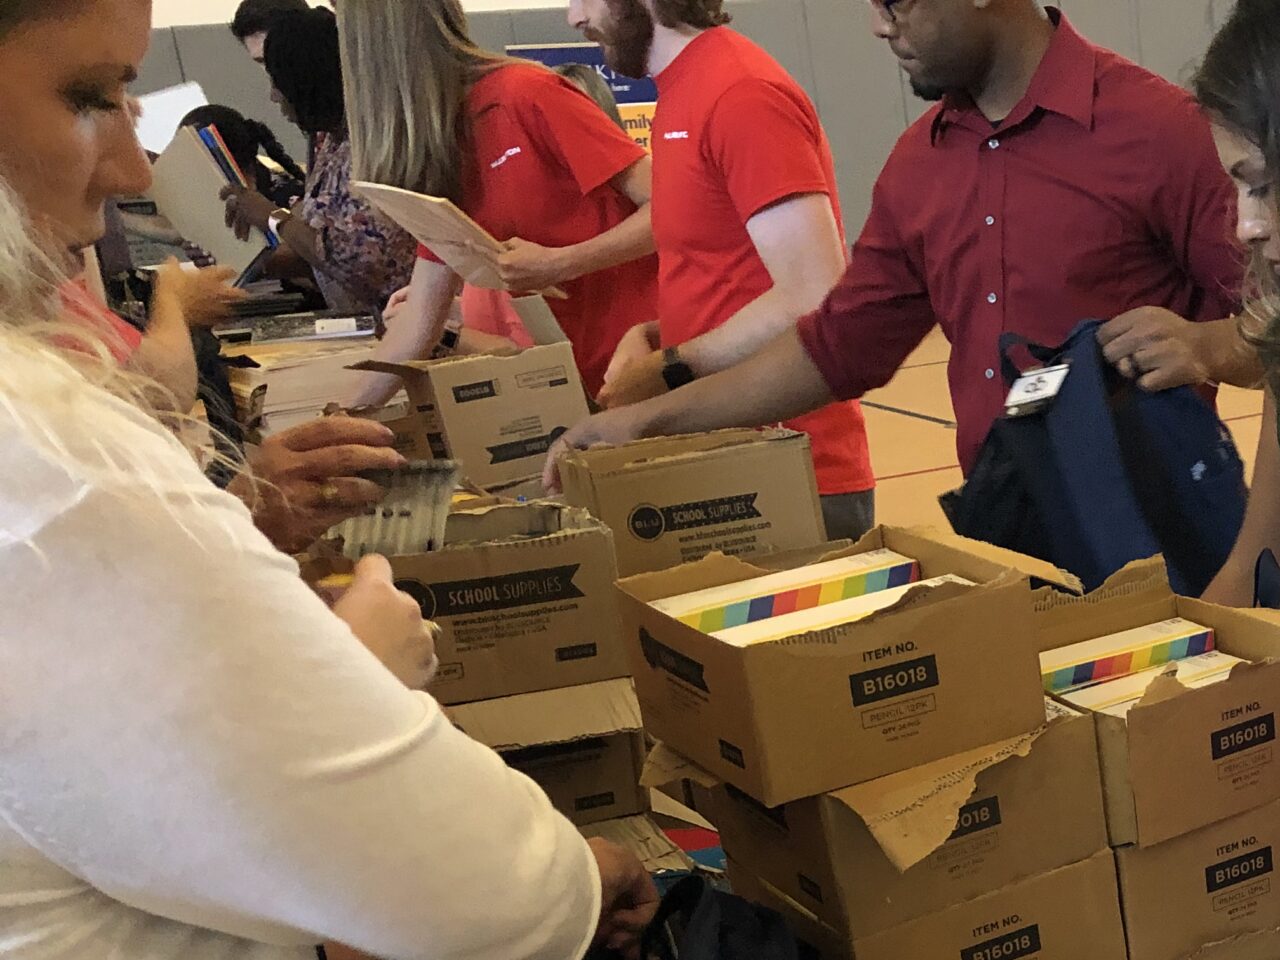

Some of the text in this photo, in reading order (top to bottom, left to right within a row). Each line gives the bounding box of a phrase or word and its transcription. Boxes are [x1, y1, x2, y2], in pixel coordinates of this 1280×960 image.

[622, 113, 652, 131] mily
[635, 517, 660, 529] BLU
[672, 502, 747, 524] SCHOOL SUPPLIES
[449, 576, 562, 606] SCHOOL SUPPLIES
[863, 641, 918, 662] ITEM NO.
[863, 666, 927, 695] B16018
[870, 706, 904, 722] PENCIL
[1221, 702, 1262, 721] ITEM NO.
[882, 726, 897, 735] QTY
[1220, 723, 1267, 750] B16018
[956, 807, 990, 829] 018
[1216, 836, 1259, 857] ITEM NO.
[1215, 856, 1265, 884] B16018
[972, 914, 1023, 938] ITEM NO.
